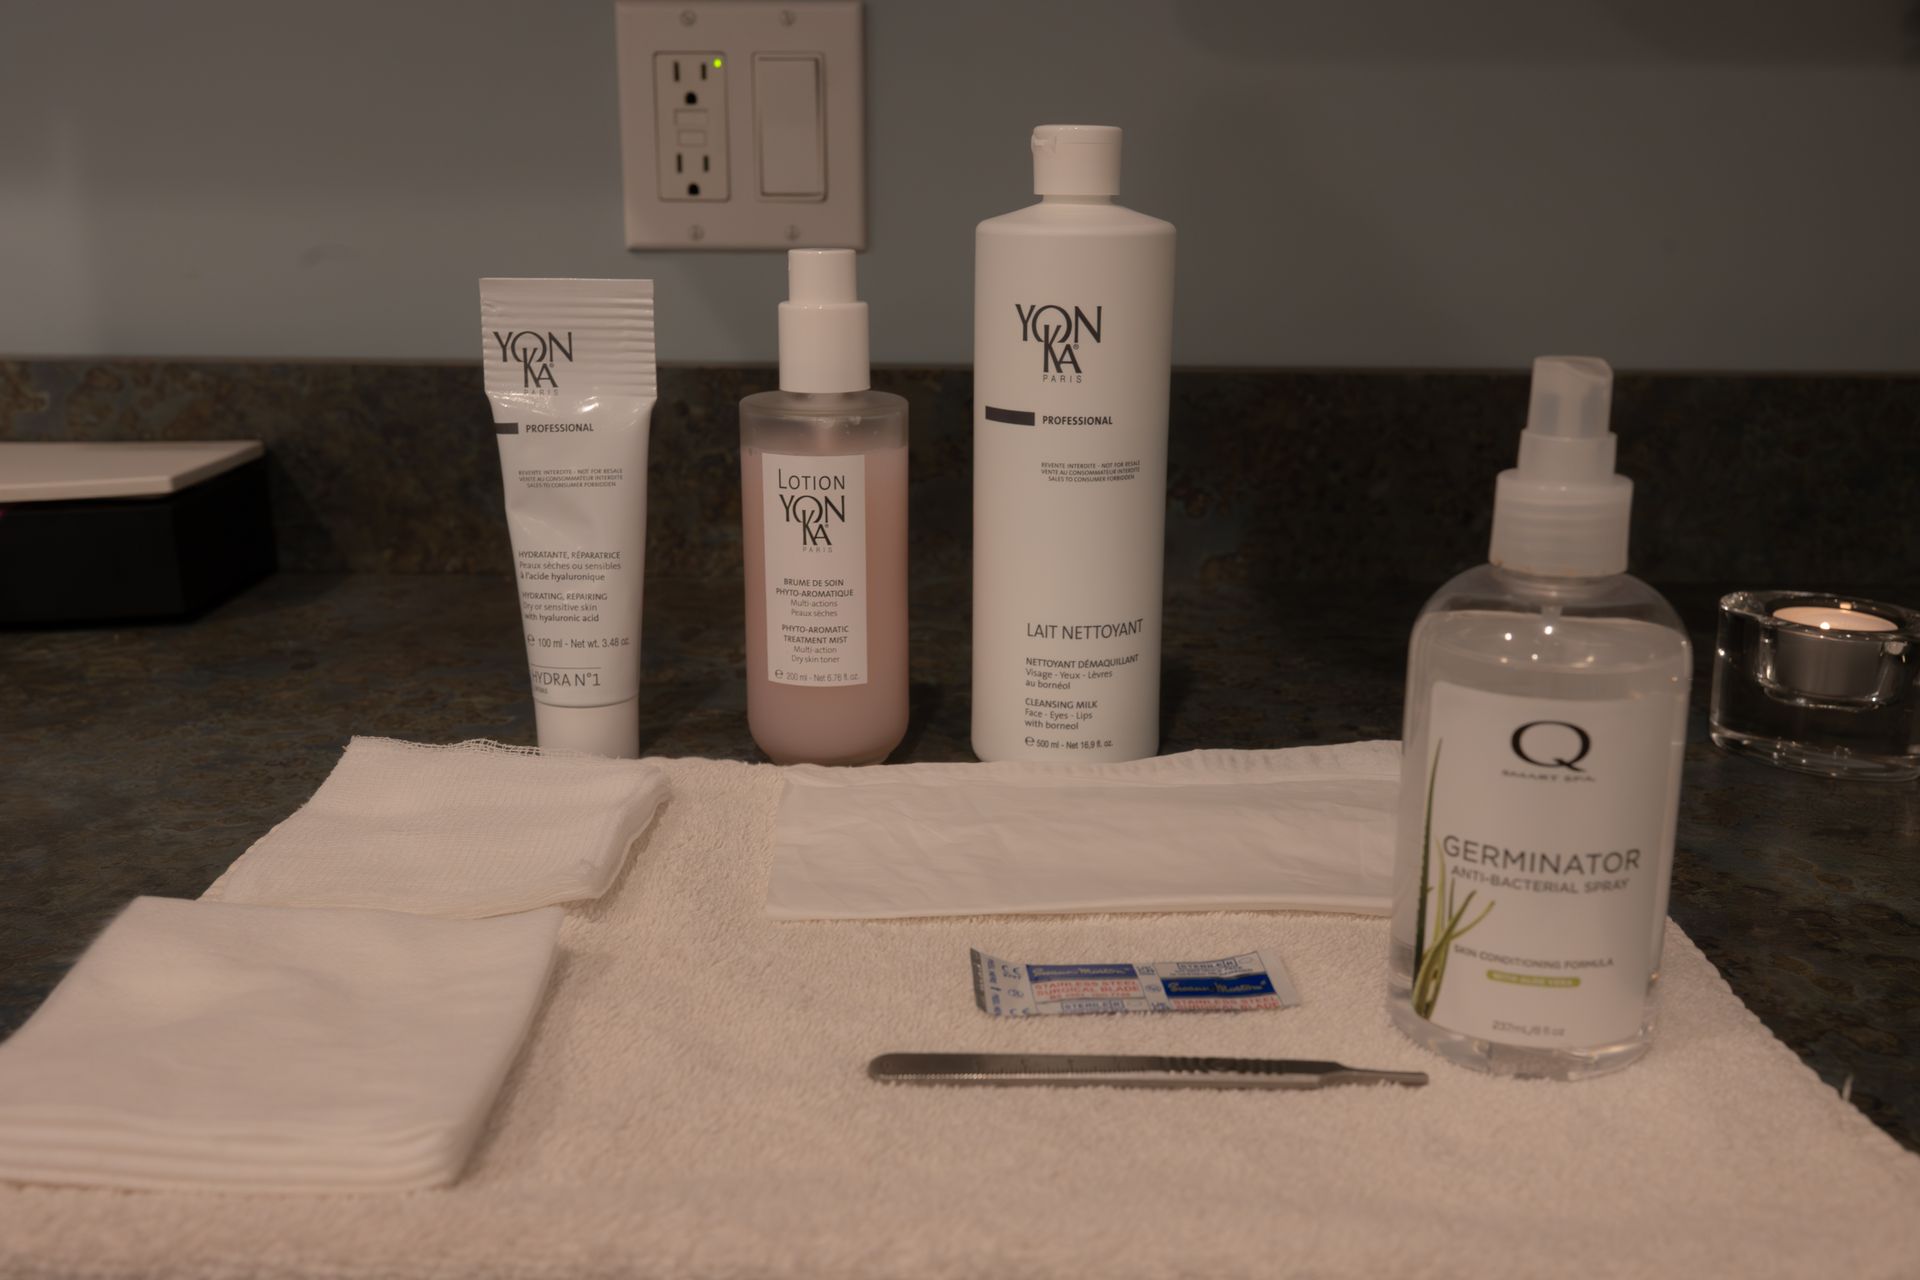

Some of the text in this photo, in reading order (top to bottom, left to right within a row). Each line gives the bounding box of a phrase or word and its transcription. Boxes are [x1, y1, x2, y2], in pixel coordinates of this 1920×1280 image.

[1015, 304, 1102, 343] YON
[493, 331, 573, 362] YON
[1043, 324, 1082, 374] KA
[522, 348, 559, 388] KA
[1042, 374, 1082, 384] PARIS
[1042, 416, 1113, 426] PROFESSIONAL
[526, 423, 594, 433] PROFESSIONAL
[779, 494, 845, 523] YON
[802, 509, 832, 546] KA
[520, 561, 541, 569] Peaux
[543, 561, 570, 570] sèches
[585, 561, 621, 570] sensibles
[551, 572, 605, 582] hyaluronique
[783, 578, 844, 587] BRUME DE SOIN
[567, 592, 607, 600] REPAIRING
[775, 587, 854, 598] PHYTO-AROMATIQUE
[544, 603, 579, 611] sensitive
[581, 603, 597, 611] skin
[539, 614, 580, 623] hyaluronic
[582, 614, 599, 622] acid
[791, 609, 812, 617] Peaux
[781, 624, 849, 634] PHYTO-AROMATIC
[1027, 618, 1143, 640] LAIT NETTOYANT
[538, 638, 551, 648] 100
[553, 638, 562, 648] ml
[571, 638, 585, 648] Net
[784, 634, 848, 644] TREATMENT MIST
[791, 655, 804, 664] Dry
[805, 655, 819, 663] skin
[1026, 653, 1139, 669] NETTOYANT DÉMAQUILLANT
[532, 671, 601, 687] HYDRA N°1
[1025, 668, 1053, 680] Visage
[1060, 671, 1080, 679] Yeux
[1088, 670, 1113, 679] Lèvres
[1037, 680, 1071, 690] bornéol
[1025, 698, 1098, 709] CLEANSING MILK
[1025, 708, 1042, 718] Face
[1050, 711, 1069, 721] Eyes
[1076, 711, 1093, 721] Lips
[1025, 719, 1079, 730] with borneol
[1036, 739, 1049, 748] 500
[1050, 739, 1059, 748] ml
[1066, 741, 1078, 749] Net
[1511, 720, 1591, 773] Q
[1443, 835, 1641, 876] GERMINATOR
[1450, 865, 1630, 894] ANTI-BACTERIAL SPRAY
[1454, 944, 1614, 970] SKIN CONDITIONING FORMULA
